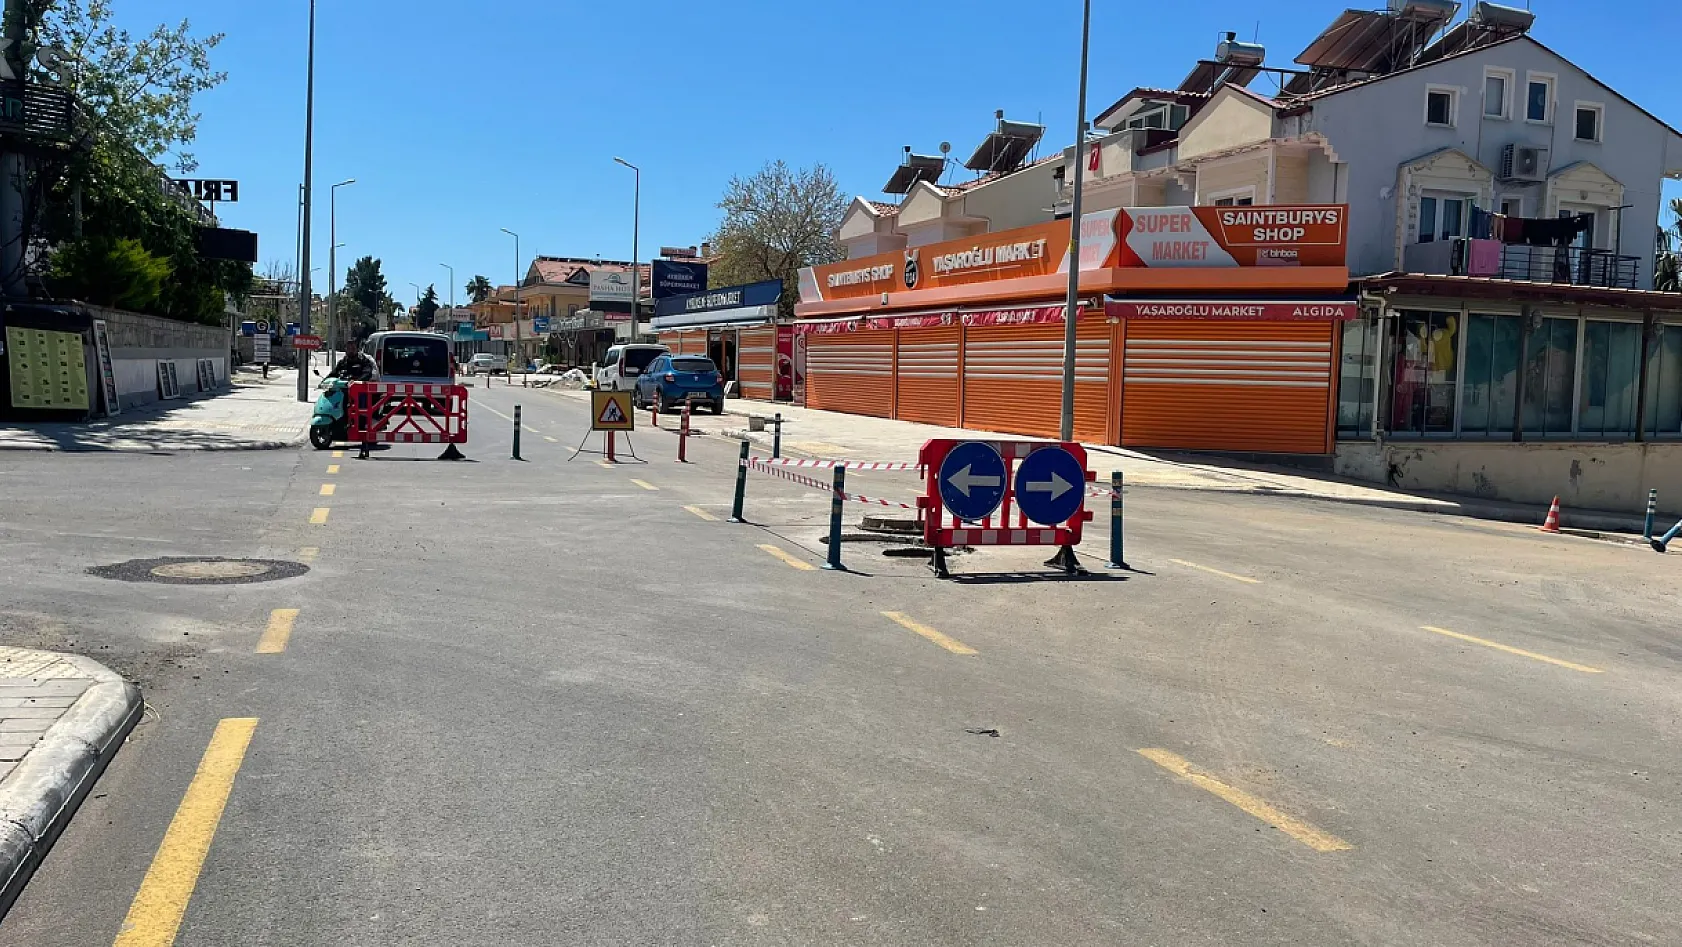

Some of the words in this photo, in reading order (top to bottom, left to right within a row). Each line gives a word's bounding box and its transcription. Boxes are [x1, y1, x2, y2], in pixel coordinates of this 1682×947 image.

[1136, 214, 1192, 233] SUPER
[1223, 210, 1338, 226] SAINTBURYS
[1253, 227, 1306, 241] SHOP
[995, 238, 1047, 264] MARKET
[1152, 241, 1210, 261] MARKET
[1211, 306, 1265, 317] MARKET
